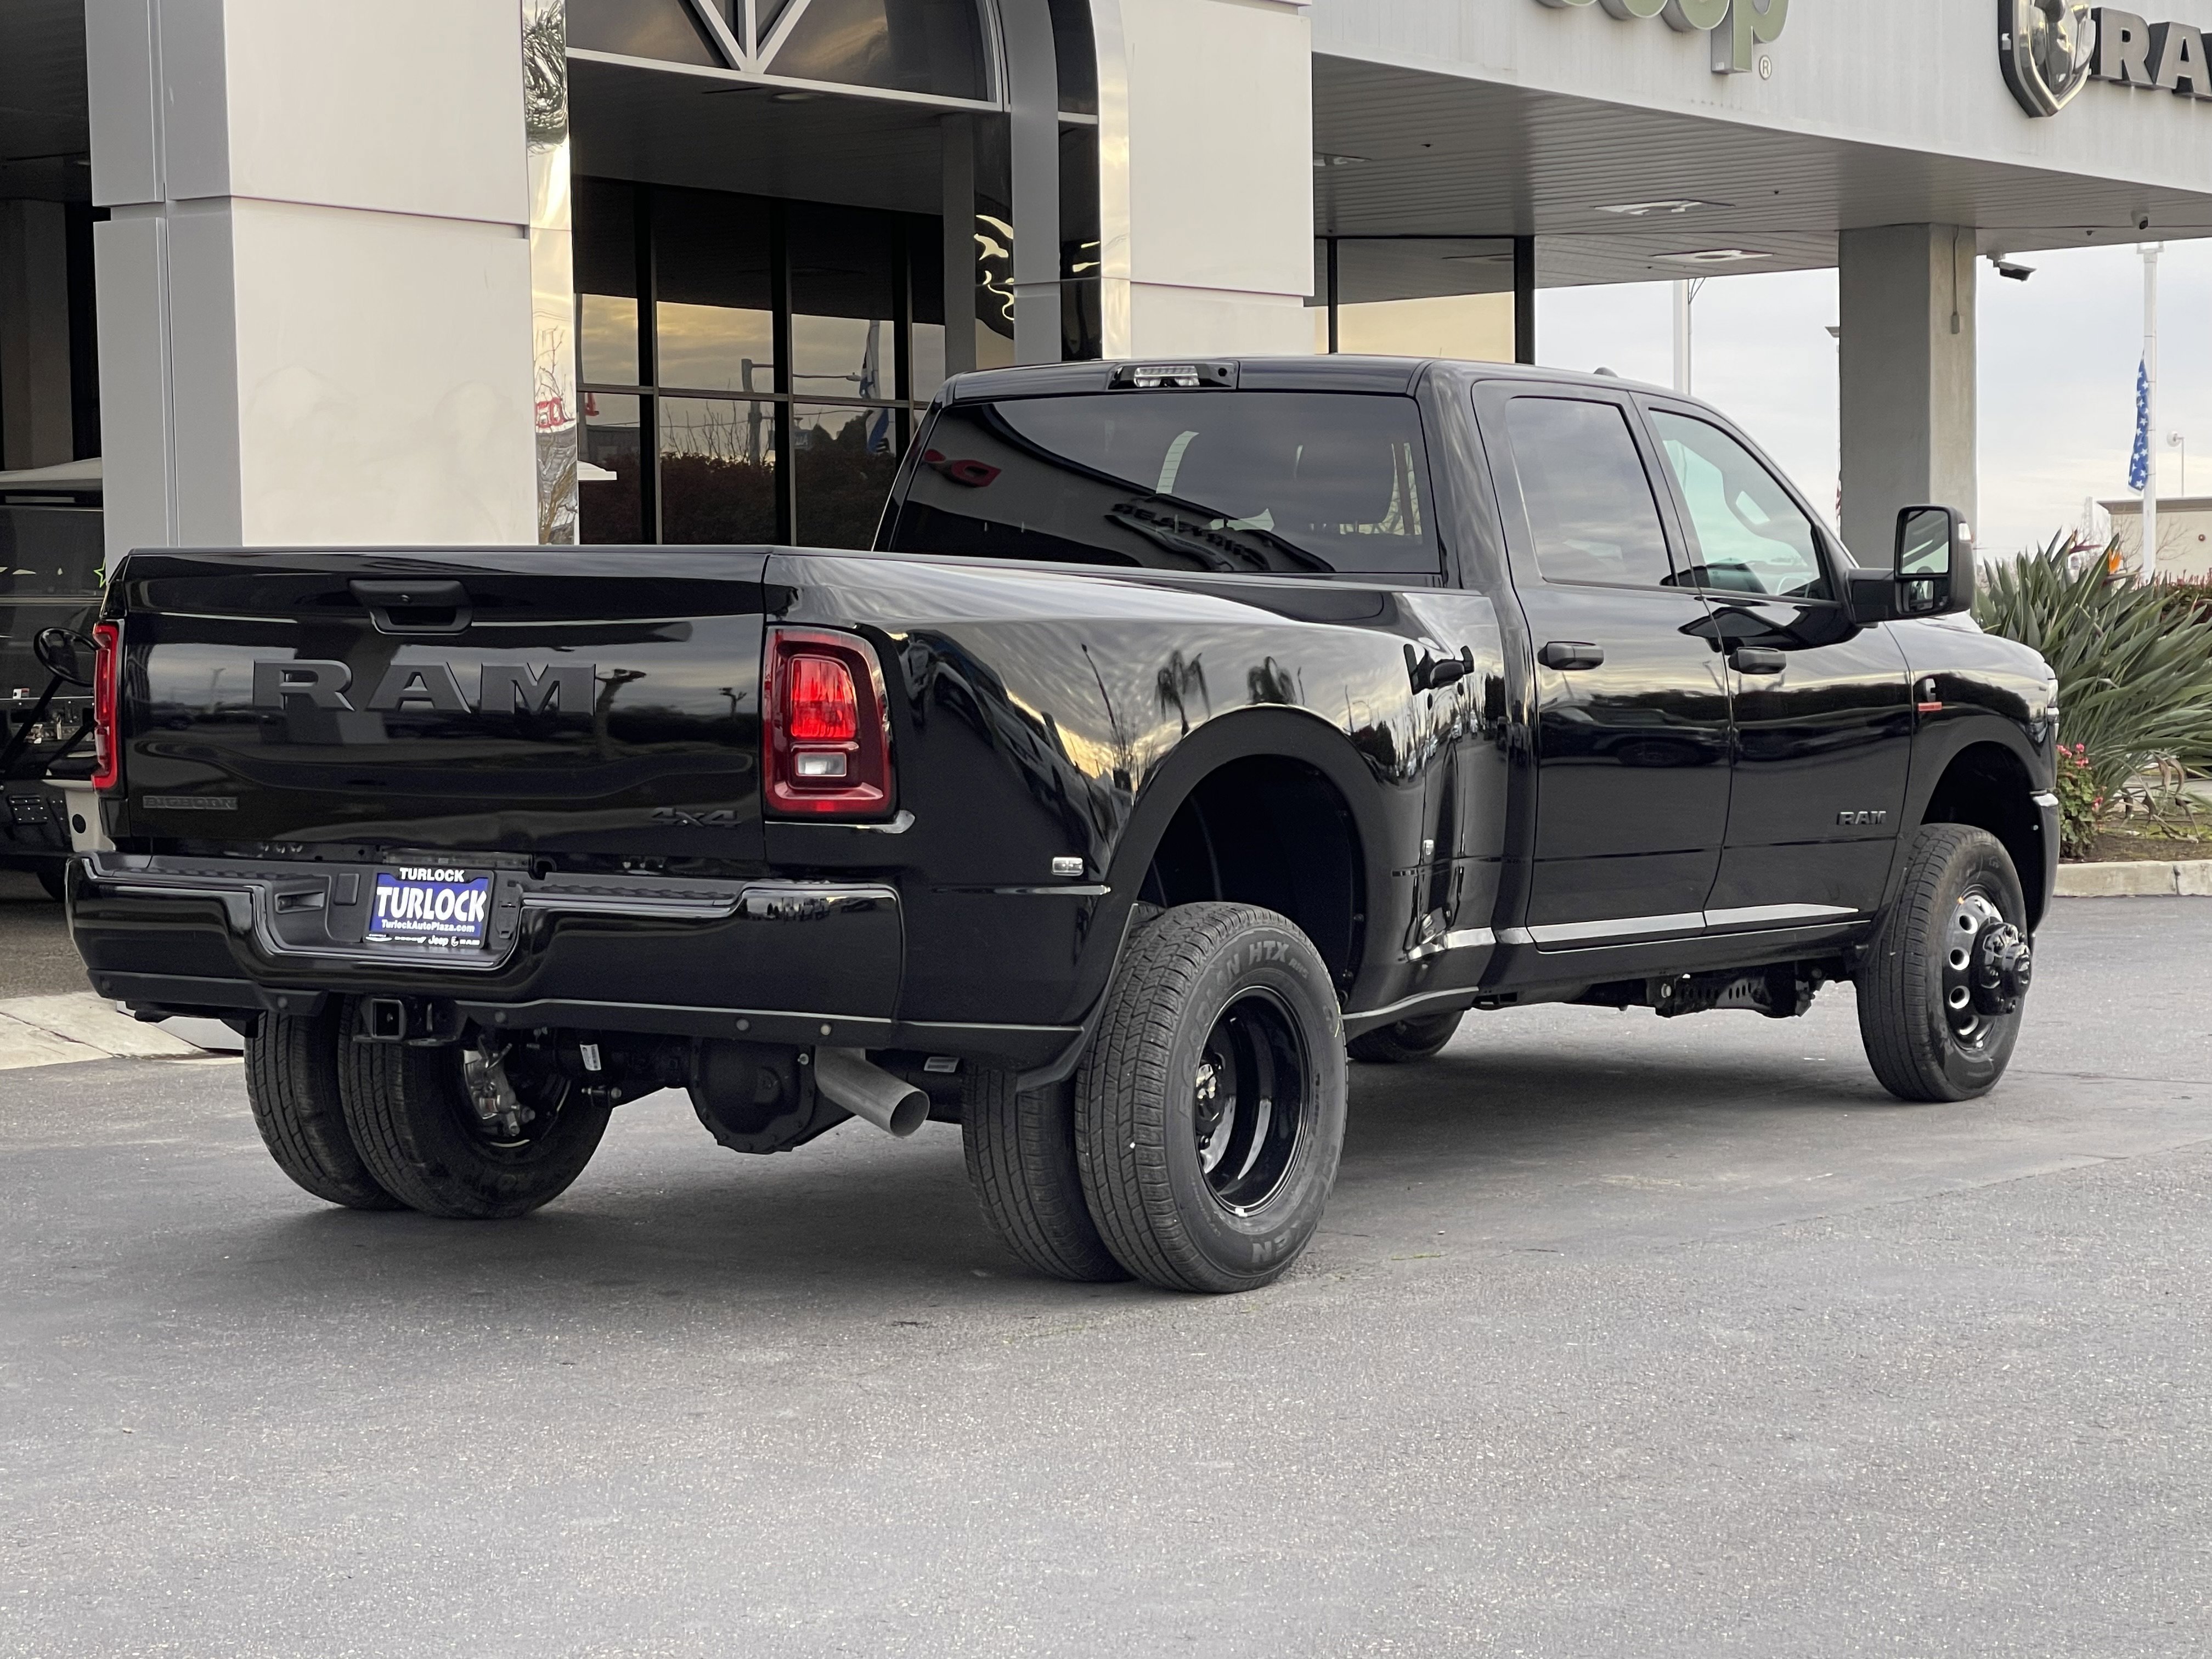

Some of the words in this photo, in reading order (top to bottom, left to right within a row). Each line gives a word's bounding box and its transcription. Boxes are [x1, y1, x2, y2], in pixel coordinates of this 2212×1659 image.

[2091, 7, 2212, 98] RA
[253, 659, 596, 715] RAM
[1836, 811, 1886, 825] RAM
[399, 867, 465, 882] TURLOCK
[376, 887, 487, 922] TURLOCK
[381, 919, 475, 933] TurlockAutoPlaza.com
[428, 935, 448, 947] Jeep
[1249, 940, 1289, 966] HTX
